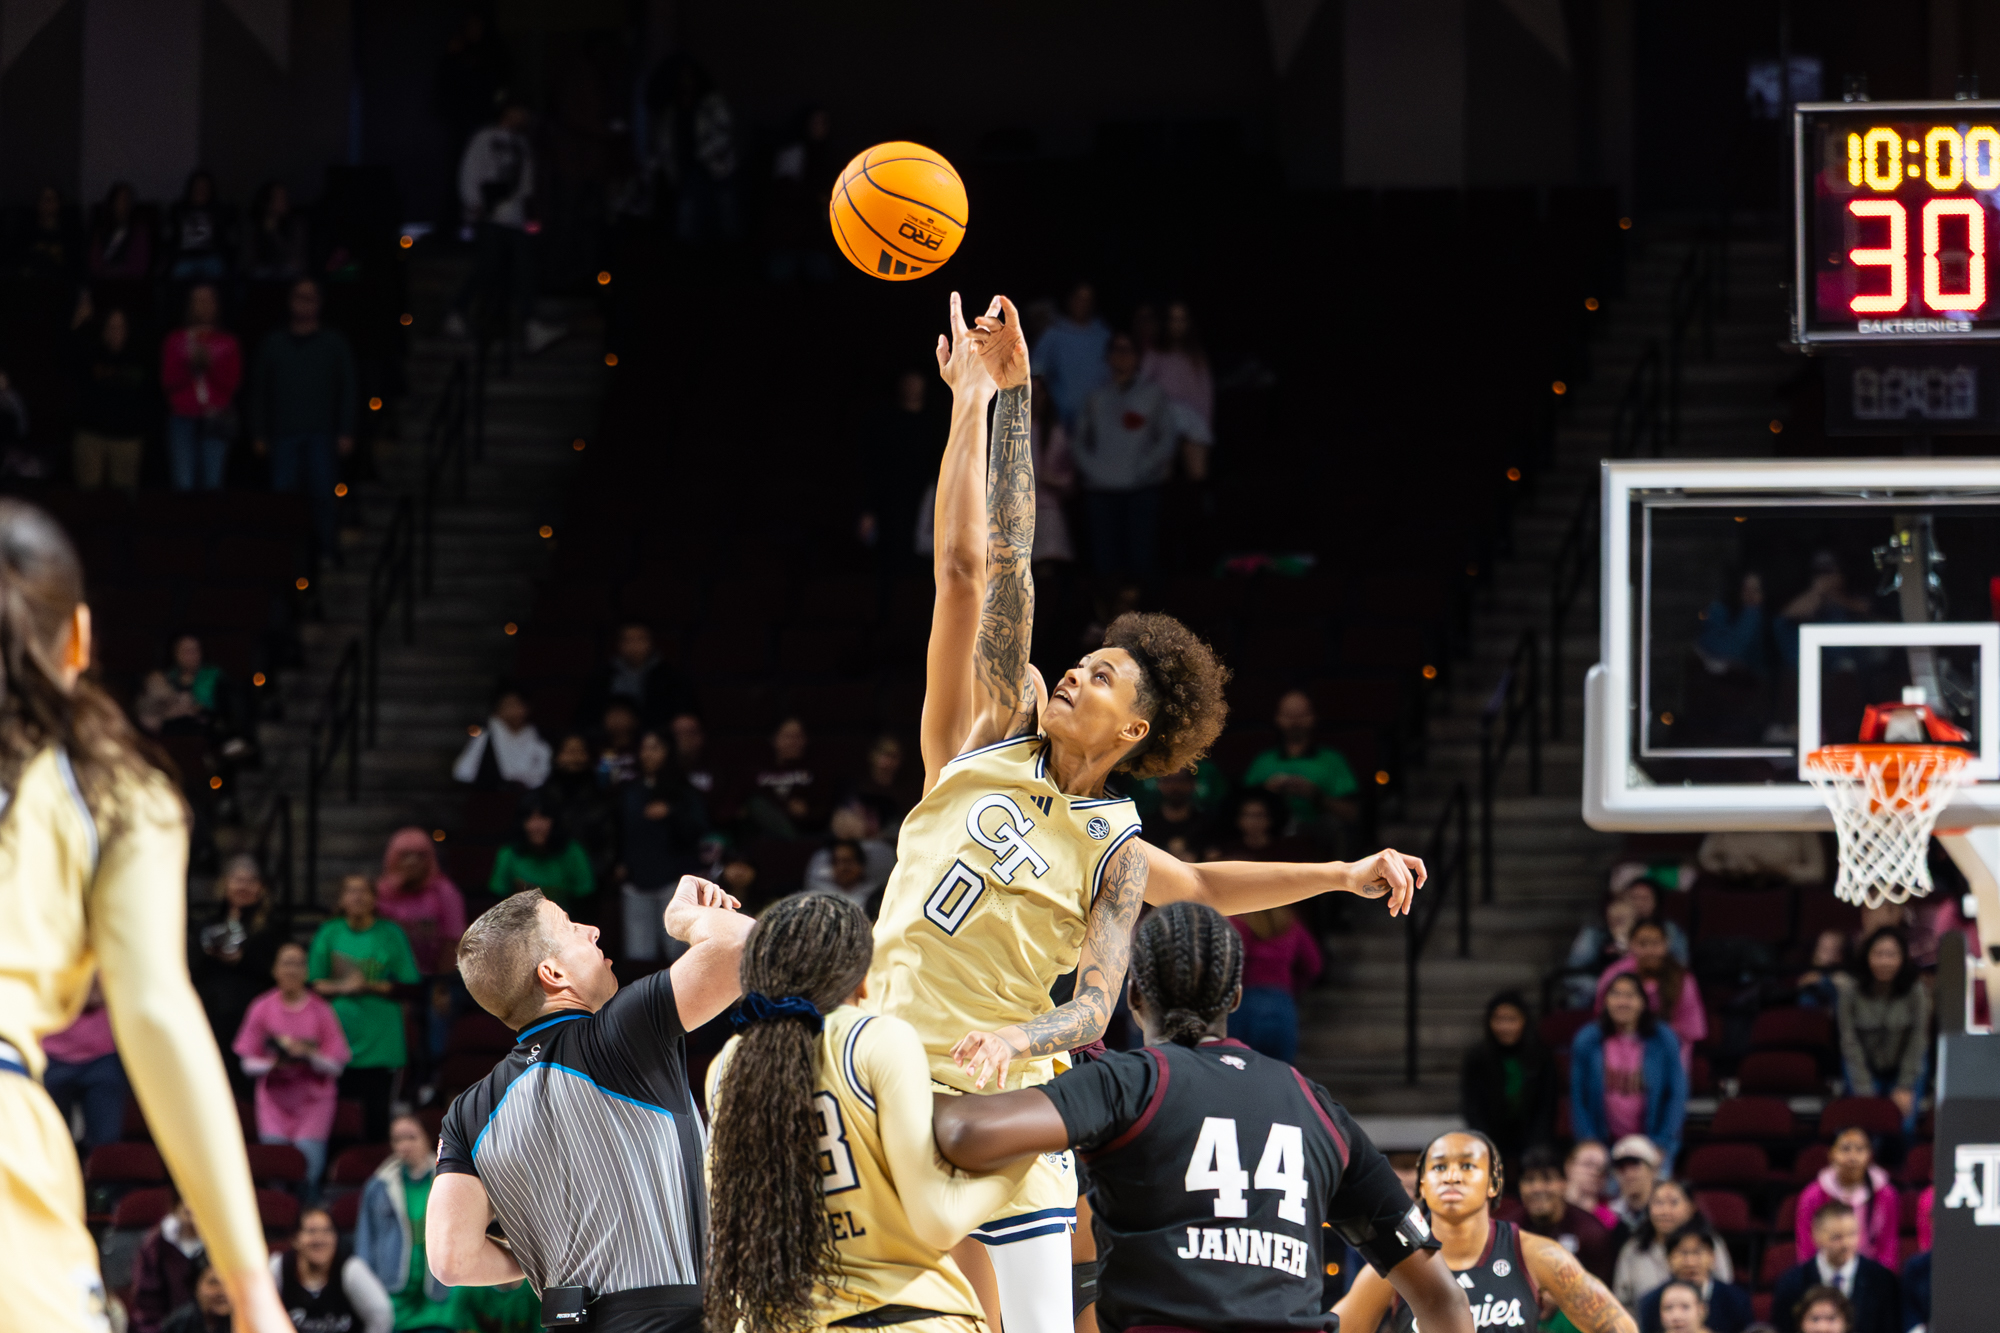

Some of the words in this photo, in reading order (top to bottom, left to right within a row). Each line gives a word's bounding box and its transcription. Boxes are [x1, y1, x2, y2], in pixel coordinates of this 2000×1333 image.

[1847, 126, 2000, 191] 10:00
[898, 222, 945, 252] PRO
[1848, 198, 1987, 312] 30
[1857, 319, 1974, 334] DAKTRONICS
[966, 793, 1050, 886] GT
[923, 858, 986, 937] 0
[1184, 1116, 1309, 1226] 44
[828, 1210, 867, 1241] EL
[1177, 1226, 1309, 1279] JANNEH
[1470, 1293, 1525, 1333] ies
